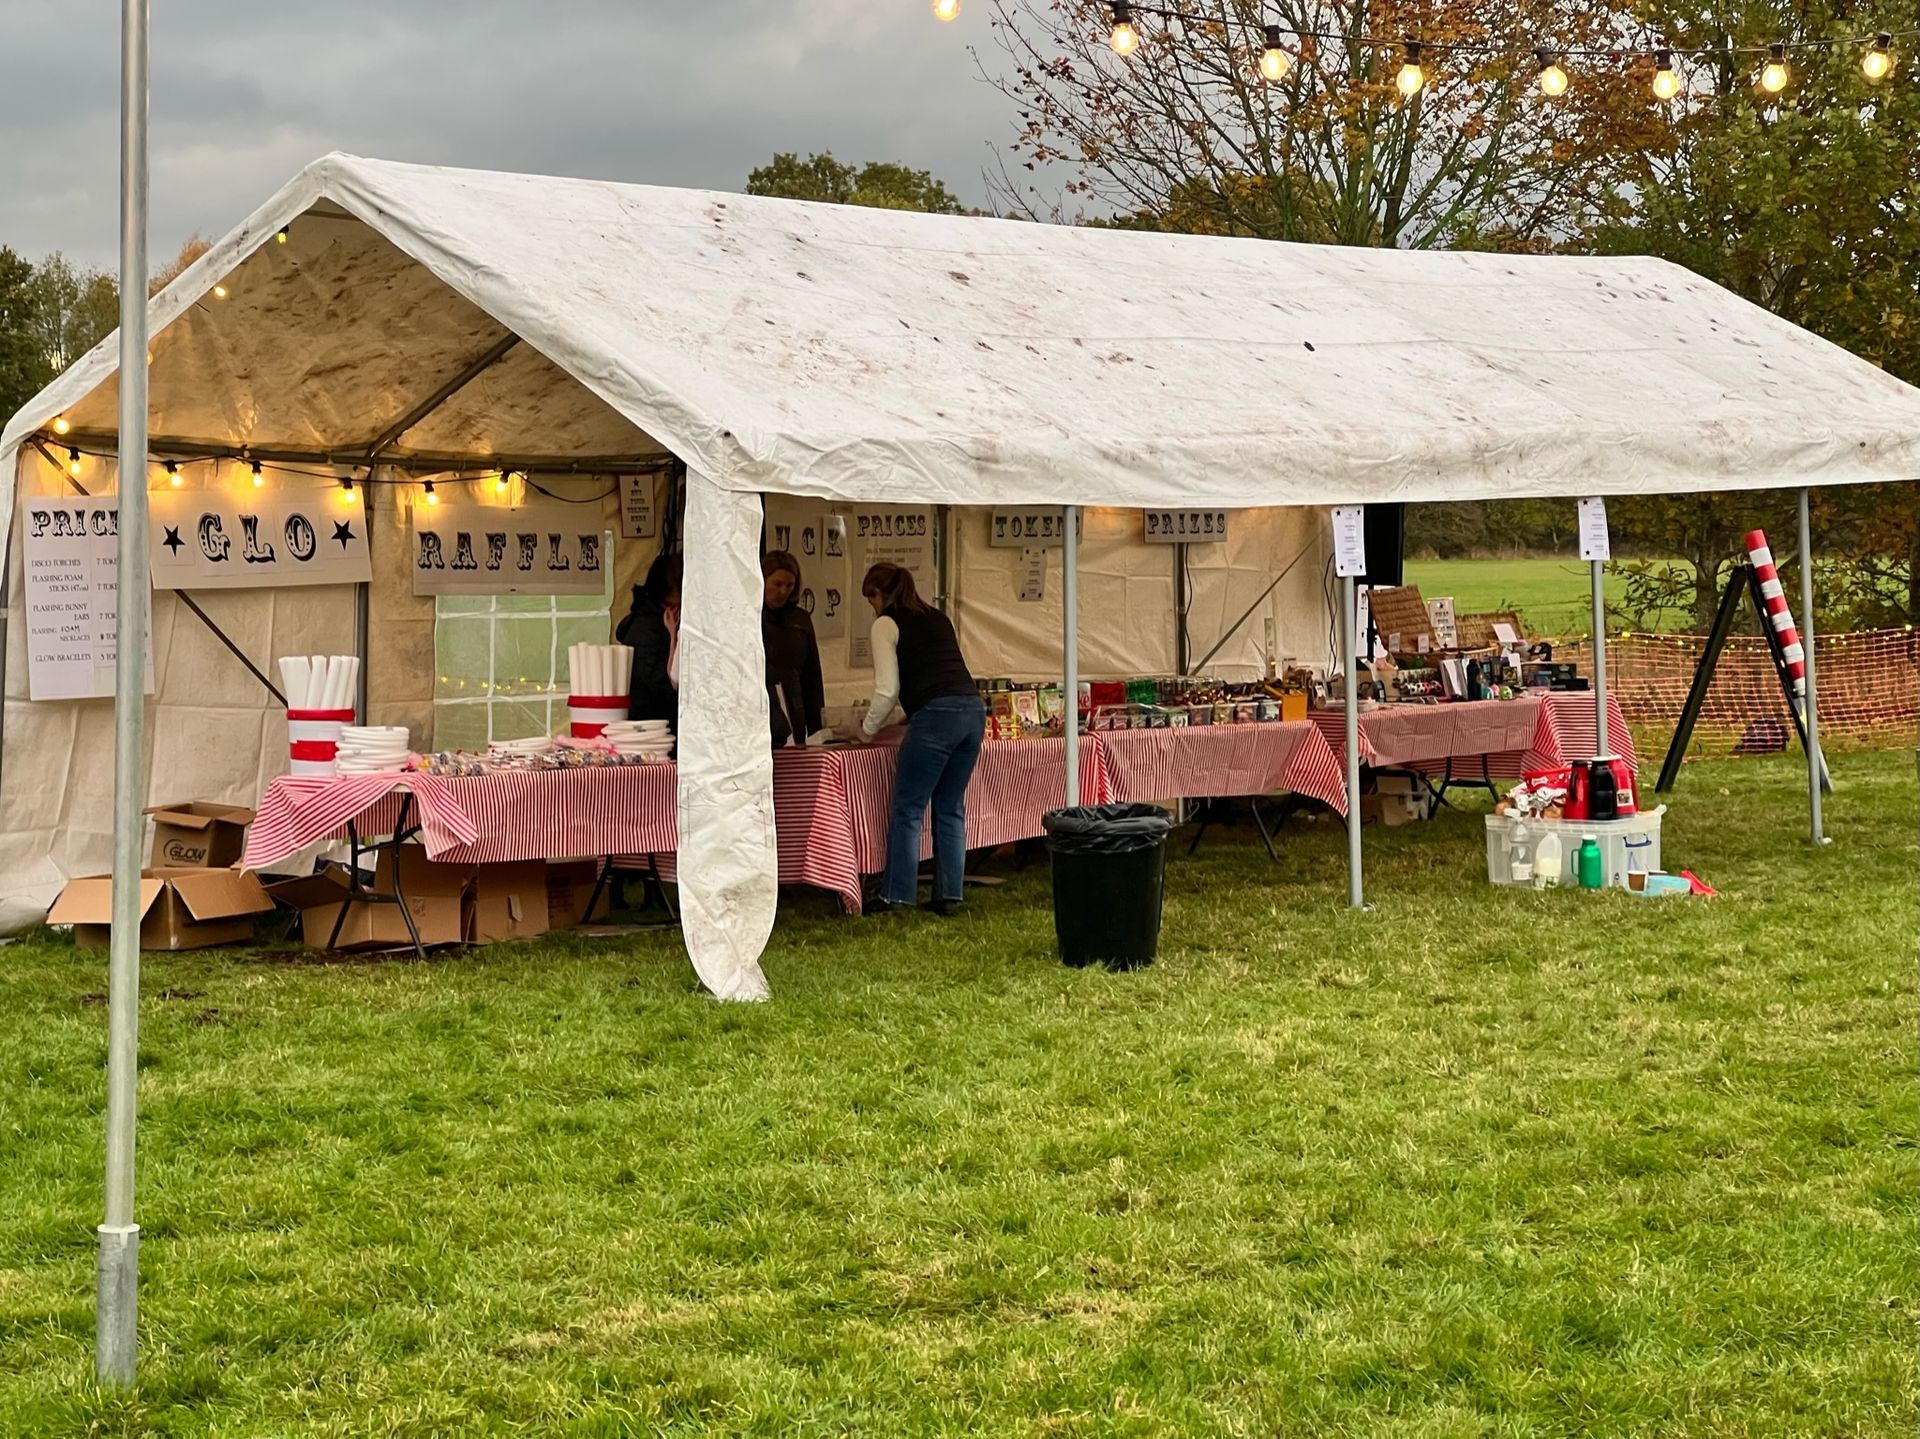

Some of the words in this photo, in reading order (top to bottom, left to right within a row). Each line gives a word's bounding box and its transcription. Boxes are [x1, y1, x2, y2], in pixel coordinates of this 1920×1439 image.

[31, 509, 118, 537] PRICE
[857, 515, 926, 537] PRICES
[1147, 512, 1225, 534] PRIZES
[198, 512, 316, 563] GLO
[418, 530, 600, 571] RAFFLE
[775, 526, 843, 557] UCK
[800, 588, 841, 617] OP
[35, 654, 56, 662] GLOW
[56, 653, 92, 661] BRACELETS
[170, 846, 207, 860] GLOW
